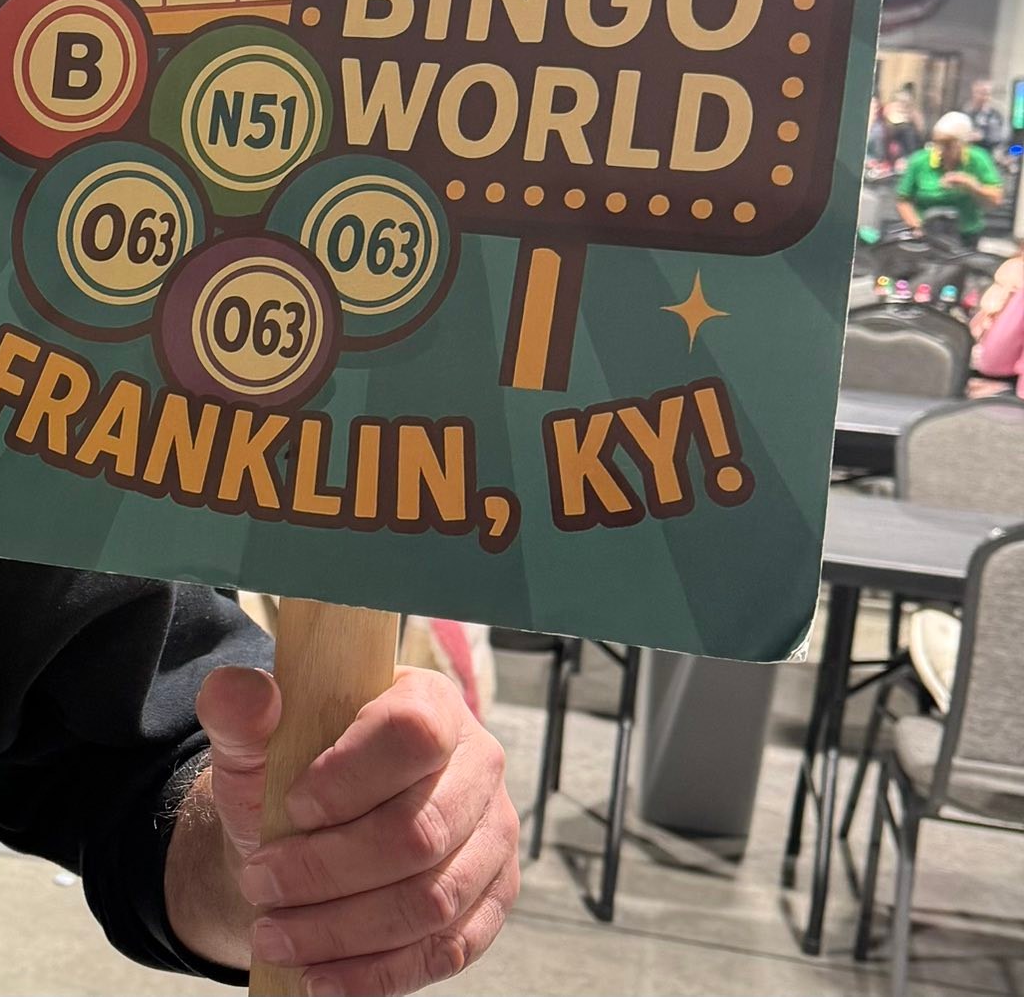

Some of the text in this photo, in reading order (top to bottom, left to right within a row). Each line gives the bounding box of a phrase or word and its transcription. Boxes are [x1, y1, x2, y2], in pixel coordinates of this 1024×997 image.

[51, 32, 103, 101] B
[207, 90, 298, 151] N51
[341, 58, 755, 172] WORLD
[80, 203, 177, 267] O63
[327, 214, 419, 279] O63
[212, 295, 307, 360] O63
[553, 388, 744, 516] KY!
